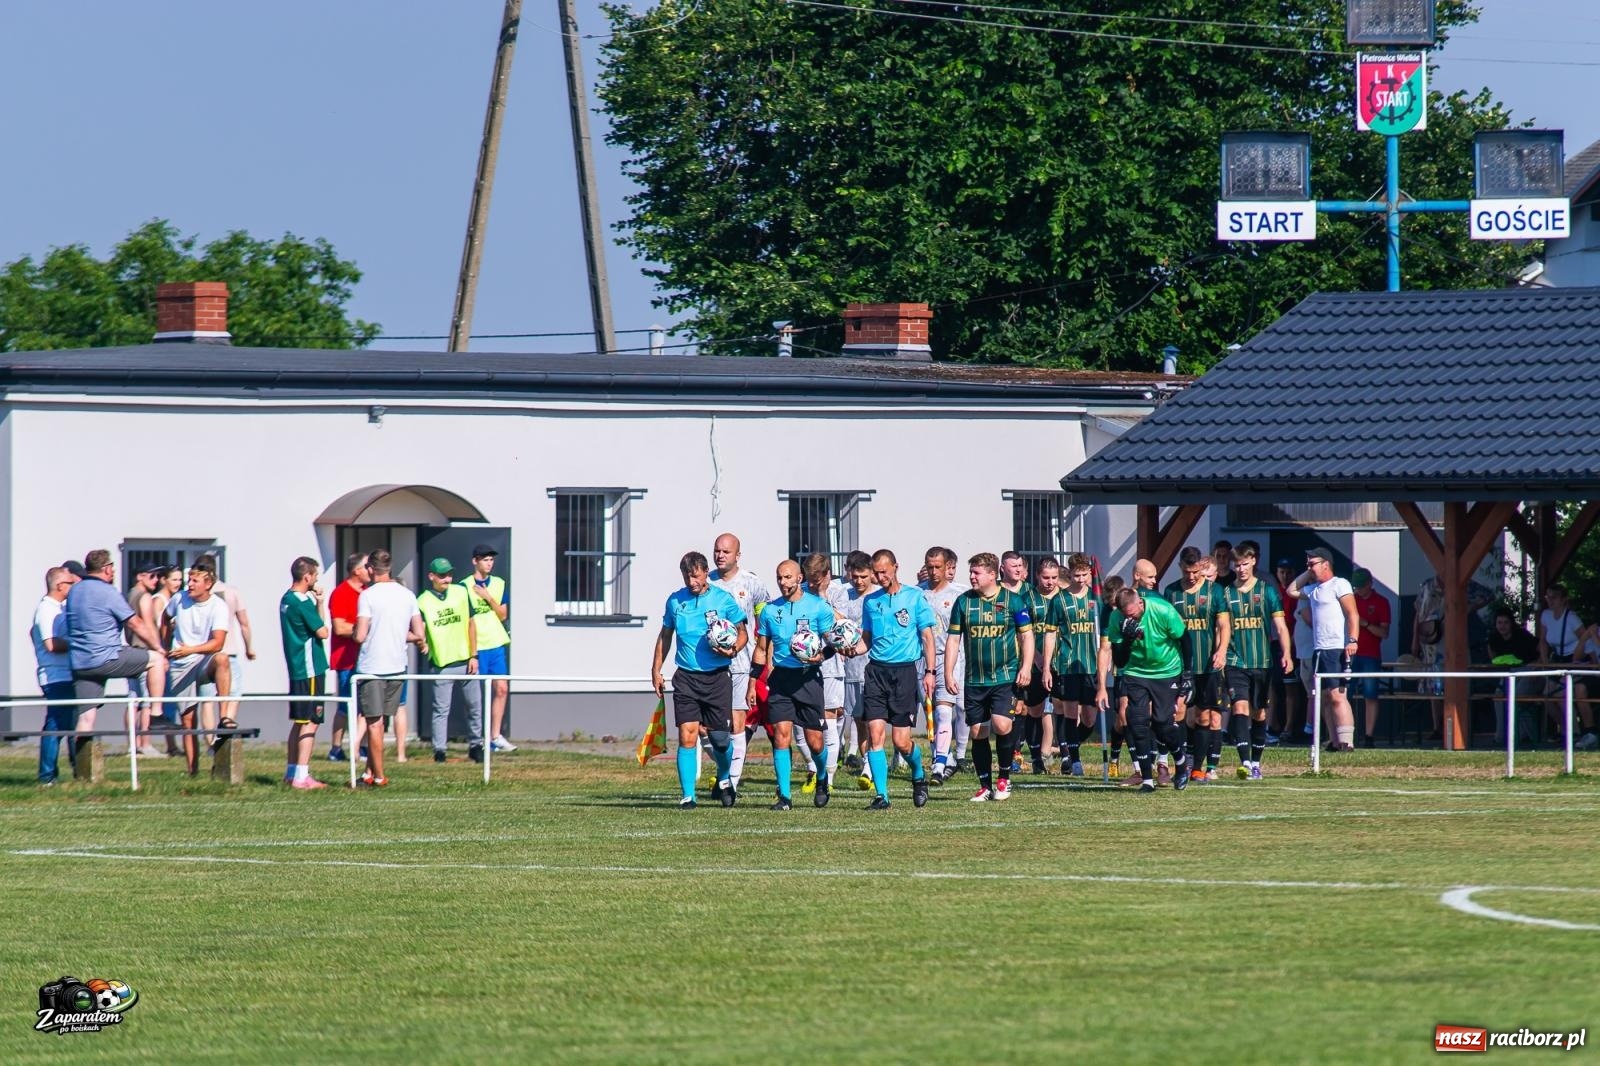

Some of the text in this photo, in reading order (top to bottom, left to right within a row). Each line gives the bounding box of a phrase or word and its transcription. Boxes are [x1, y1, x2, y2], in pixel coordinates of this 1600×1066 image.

[1362, 54, 1396, 62] Pietrowice
[1376, 90, 1409, 107] START
[1229, 211, 1304, 234] START
[1477, 205, 1566, 233] GOŚCIE
[1078, 610, 1086, 618] 14
[1187, 604, 1196, 615] 11
[1244, 603, 1249, 614] 7
[982, 612, 992, 622] 16
[1071, 622, 1094, 634] START
[1183, 618, 1206, 630] ART
[1234, 617, 1262, 630] START
[971, 626, 1004, 638] START
